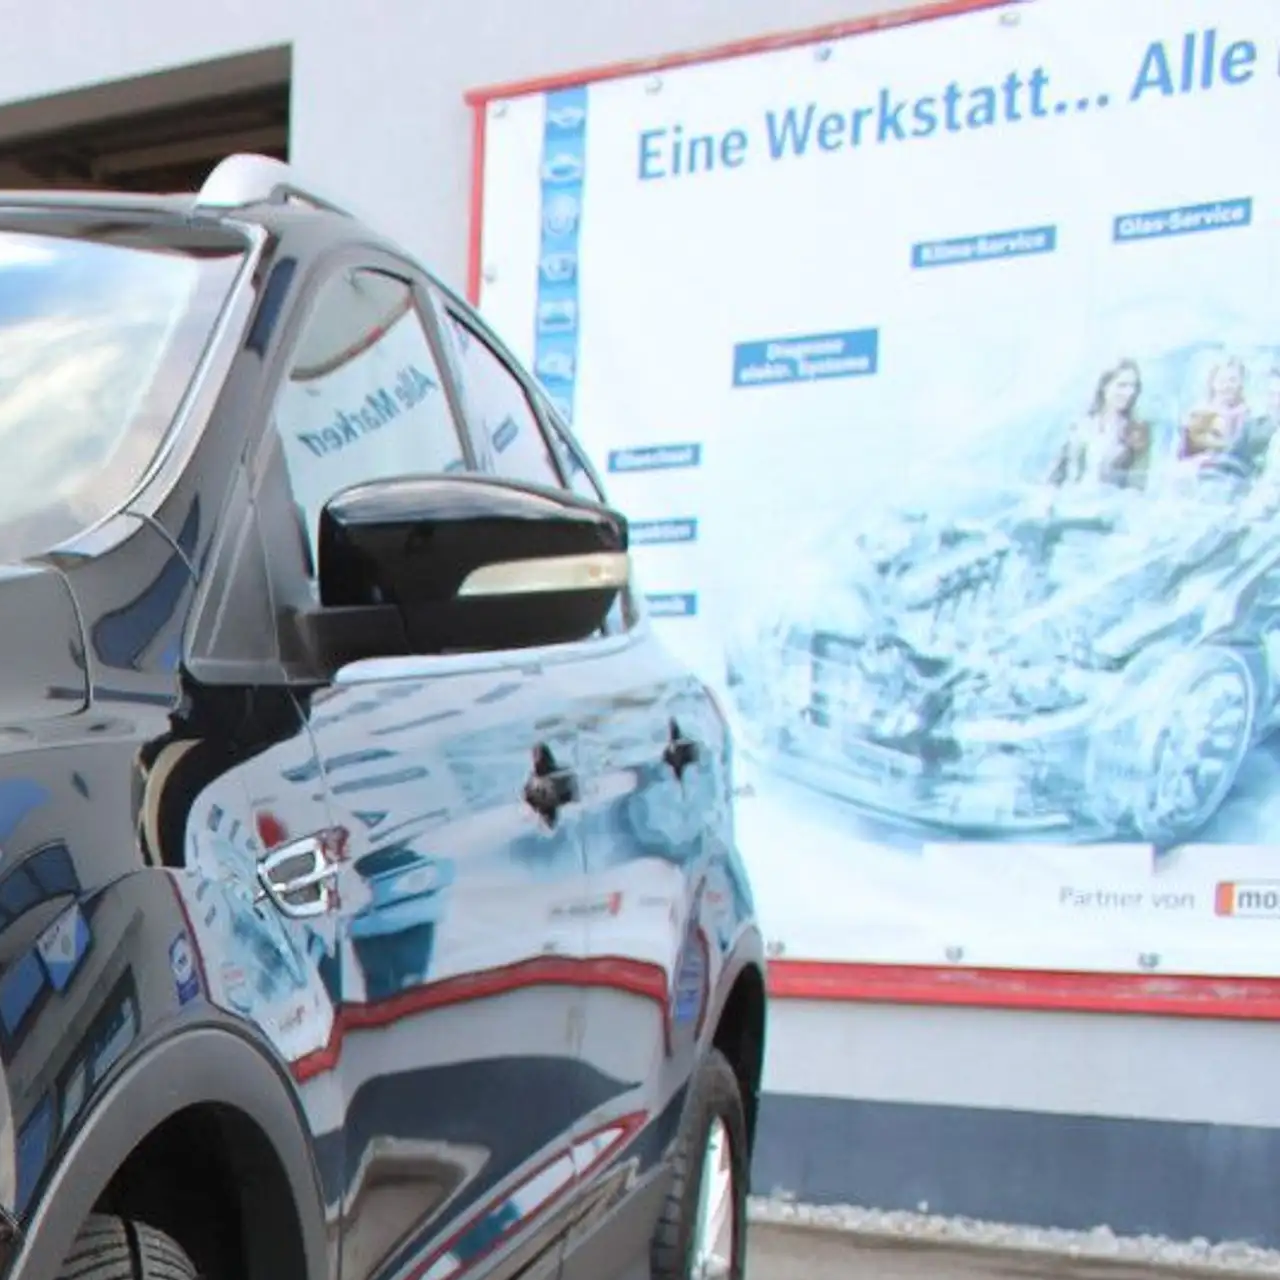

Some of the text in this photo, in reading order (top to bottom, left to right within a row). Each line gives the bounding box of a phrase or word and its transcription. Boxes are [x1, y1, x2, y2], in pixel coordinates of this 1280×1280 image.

[637, 28, 1258, 180] Eine Werkstatt... Alle
[1119, 203, 1246, 237] Glas-Service
[1059, 885, 1196, 910] Partner von
